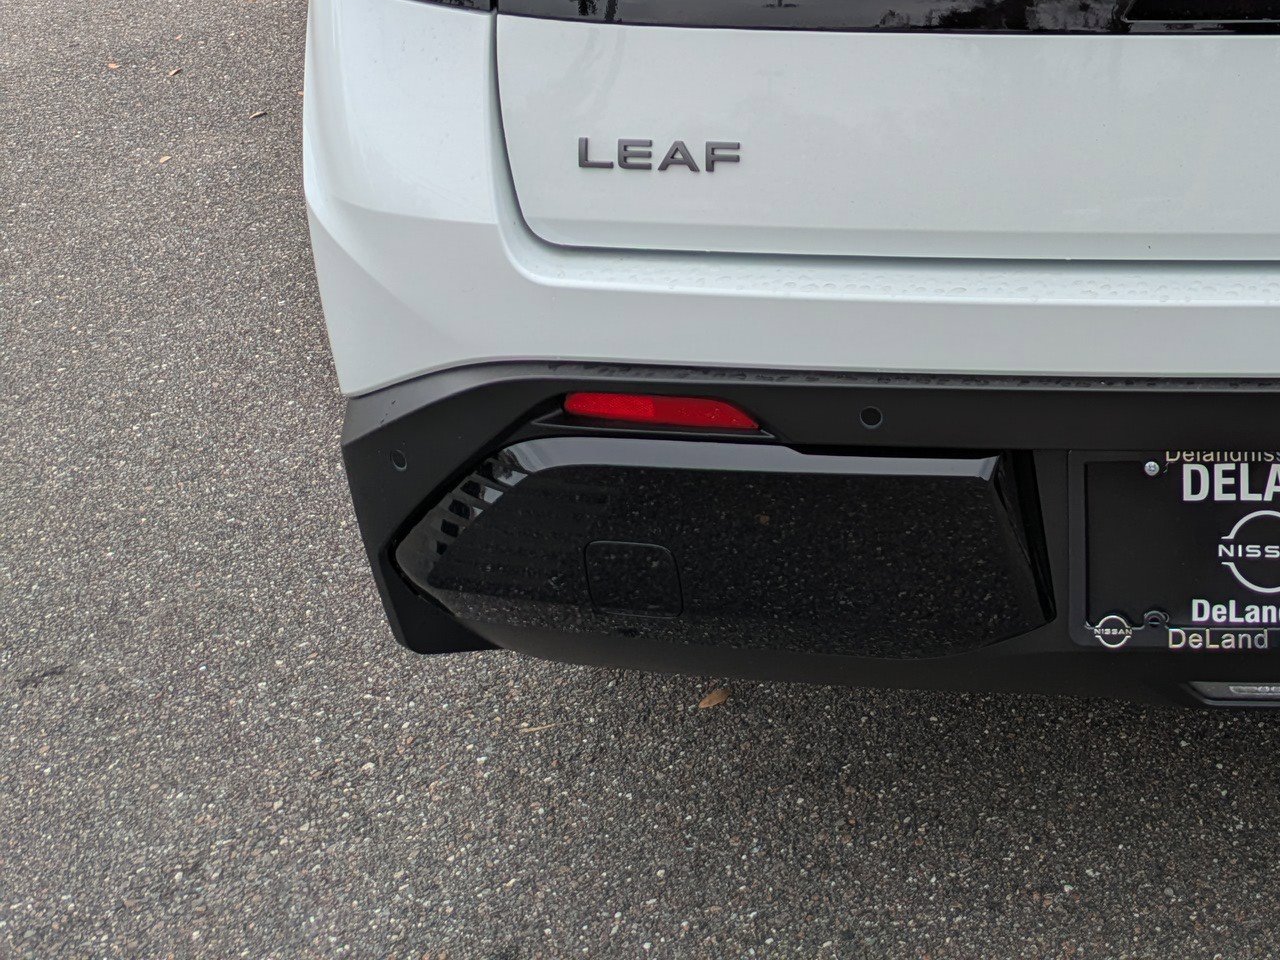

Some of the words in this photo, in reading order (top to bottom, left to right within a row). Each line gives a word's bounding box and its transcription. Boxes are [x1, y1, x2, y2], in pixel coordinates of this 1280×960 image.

[578, 137, 741, 172] LEAF
[1094, 627, 1132, 636] NISSAN
[1168, 629, 1269, 649] DeLand
